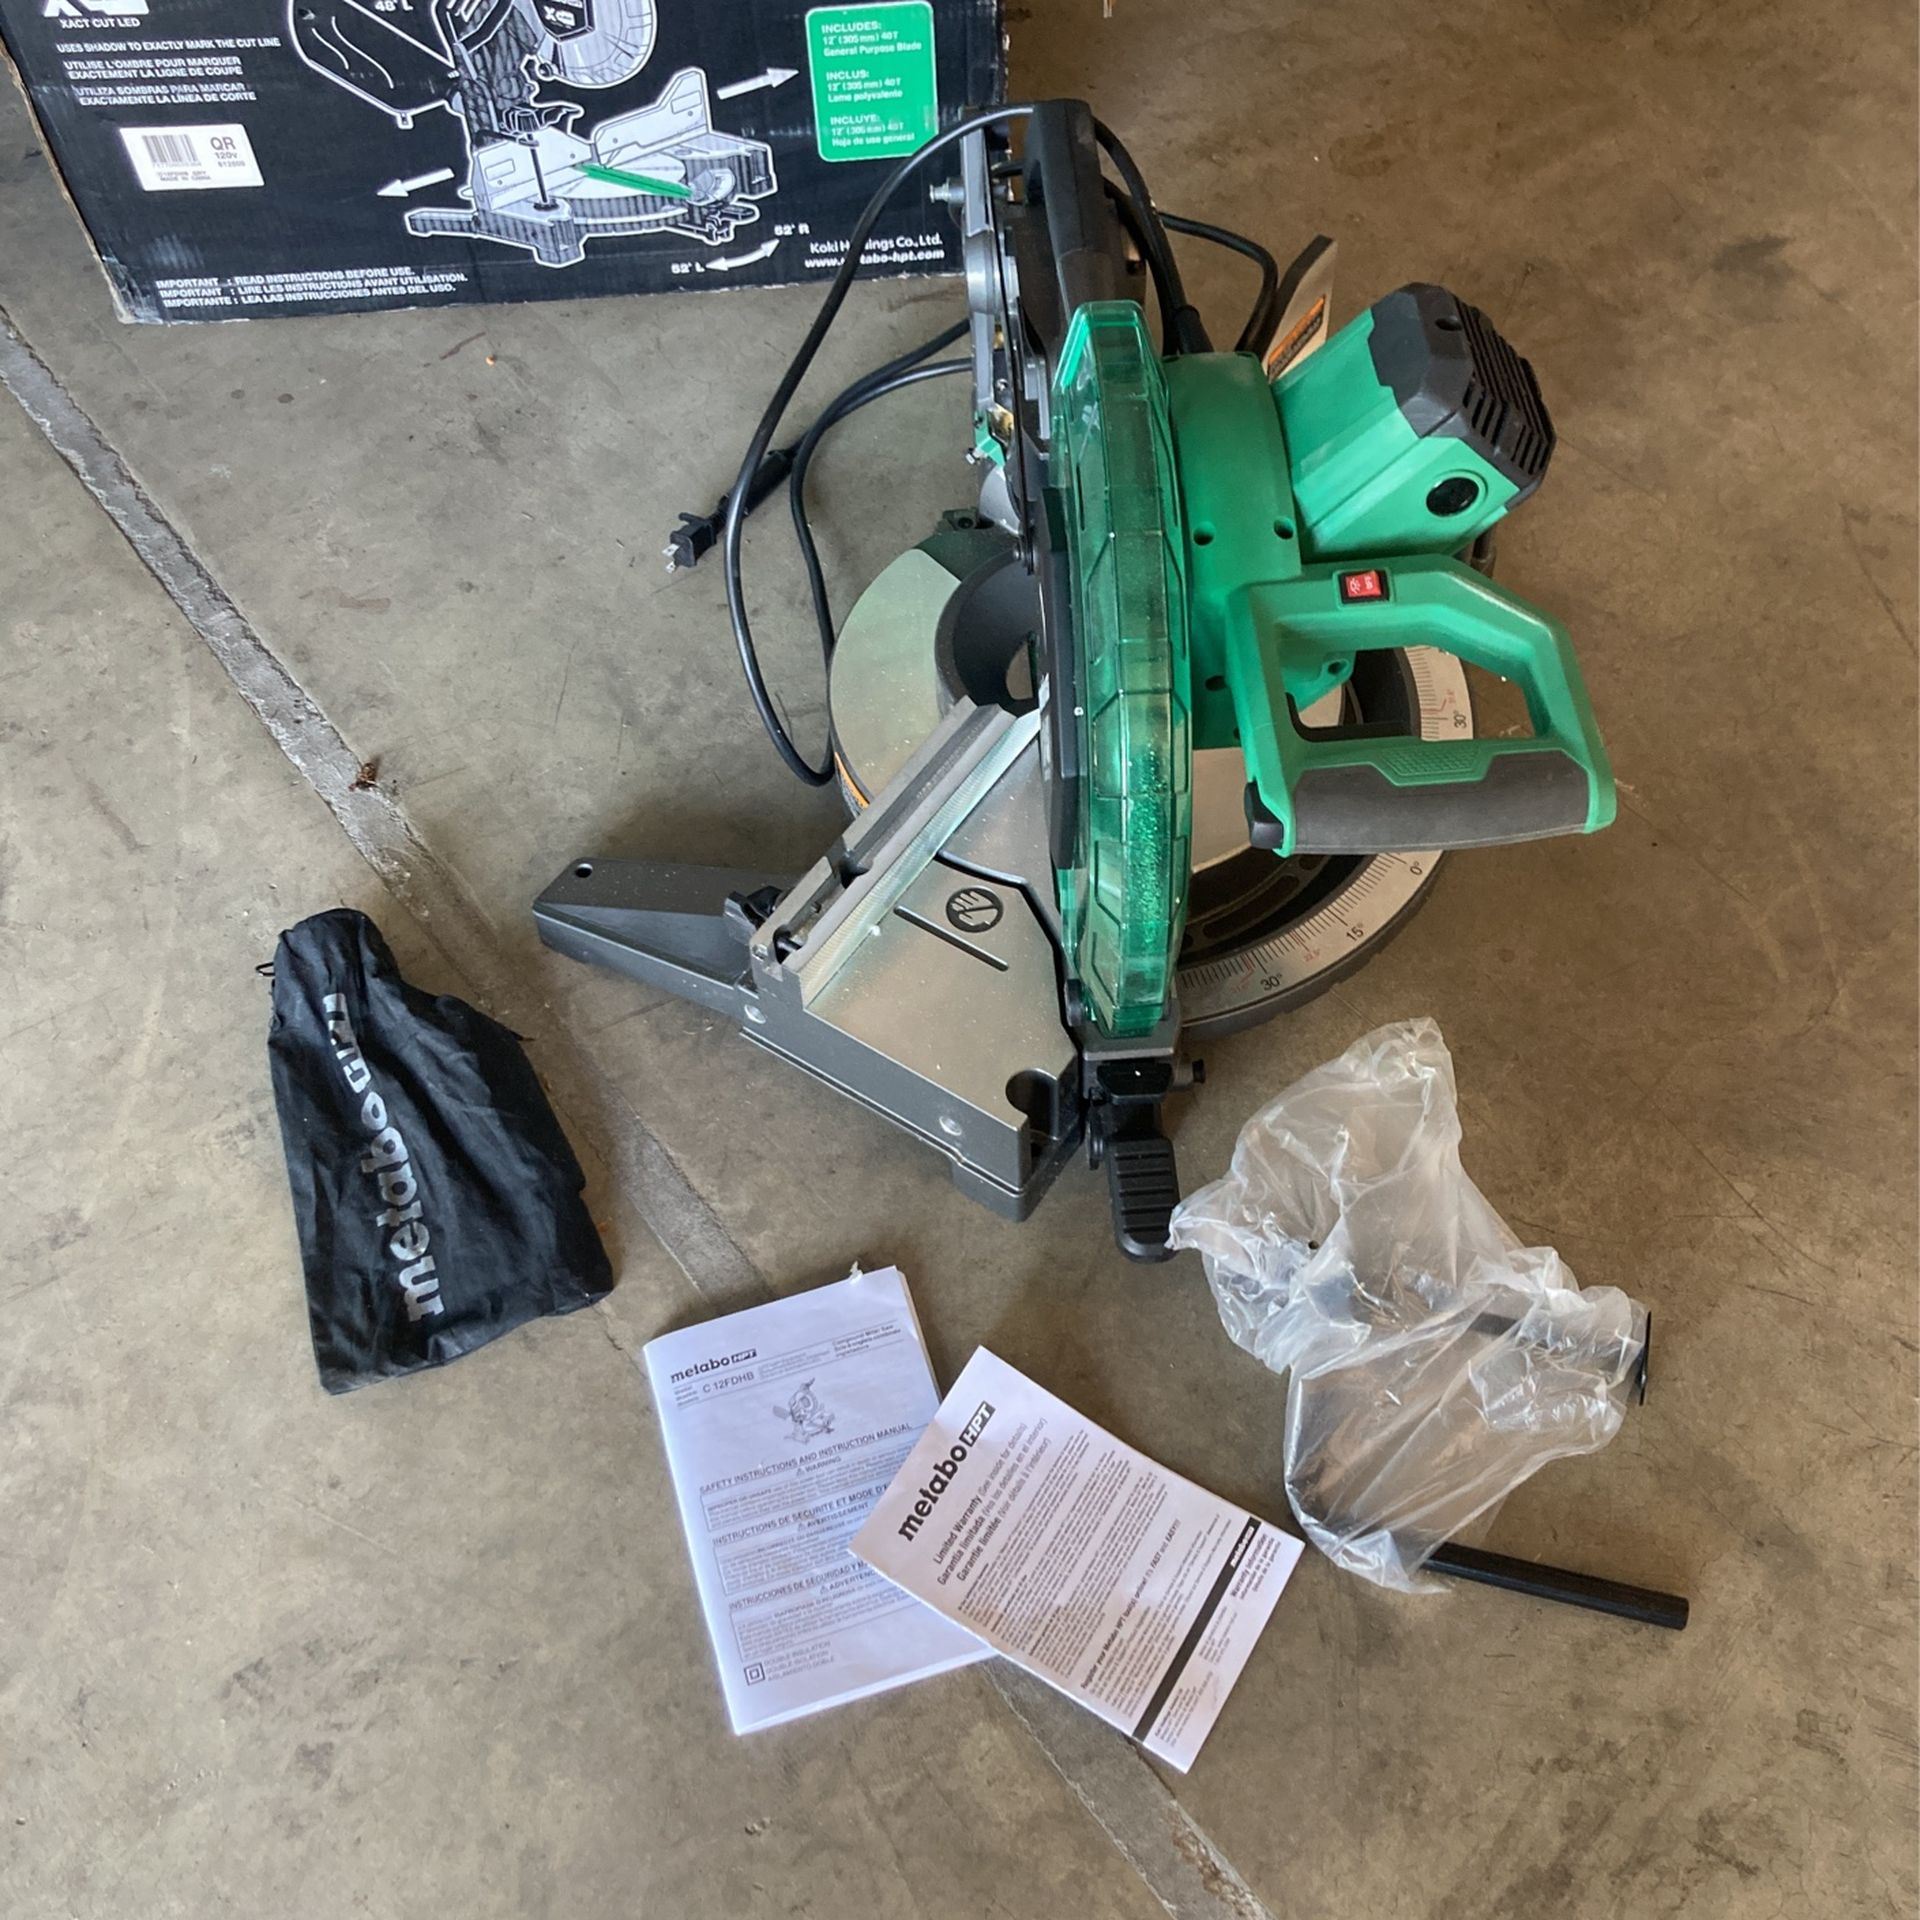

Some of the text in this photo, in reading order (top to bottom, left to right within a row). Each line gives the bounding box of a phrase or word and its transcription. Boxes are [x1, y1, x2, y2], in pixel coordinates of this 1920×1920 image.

[60, 17, 141, 29] XACT CUT LED
[821, 20, 881, 34] INCLUDES:
[56, 37, 281, 53] USES SHADOW TO EXACTLY MARK THE CUT LINE
[823, 46, 857, 57] General
[63, 56, 242, 70] UTILISE L'OMBRE POUR MARQUER
[68, 66, 243, 80] EXACTEMENT LA LIGNE DE COUPE
[826, 69, 869, 81] INCLUS:
[74, 82, 246, 96] UTILIZA SOMBRAS PARA MARCAR
[79, 95, 156, 106] EXACTAMENTE
[155, 94, 171, 103] LA
[203, 92, 219, 102] DE
[219, 91, 257, 101] CORTE
[210, 136, 236, 150] QR
[798, 223, 810, 234] R
[810, 240, 839, 254] Koki
[155, 266, 415, 289] IMPORTANT READ INSTRUCTIONS BEFORE USE.
[159, 273, 468, 299] IMPORTANT LIRE LES INSTRUCTIONS AVANT UTILISATION.
[162, 283, 456, 308] IMPORTANTE LEA LAS INSTRUCCIONES ANTES DEL USO.
[1346, 922, 1364, 942] 15°
[1260, 972, 1283, 991] 30°
[361, 1091, 444, 1322] metabo
[670, 1356, 730, 1382] metabo
[701, 1371, 754, 1394] C 12FDHB
[699, 1422, 912, 1494] SAFETY INSTRUCTIONS AND INSTRUCTION MANUAL
[804, 1456, 842, 1472] WARNING
[897, 1400, 995, 1542] metabo HPT
[805, 1501, 868, 1528] AVERTISSEMENT
[932, 1531, 958, 1565] Limited
[952, 1494, 982, 1532] Warranty
[988, 1458, 1005, 1480] inside
[999, 1447, 1010, 1460] for
[712, 1519, 777, 1546] INSTRUCTIONS
[777, 1514, 790, 1525] DE
[835, 1496, 846, 1507] ET
[848, 1487, 874, 1502] MODE
[958, 1515, 985, 1550] limitada
[955, 1544, 983, 1581] Garantie
[1149, 1551, 1161, 1568] FAST
[727, 1584, 792, 1610] INSTRUCCIONES
[792, 1580, 805, 1591] DE
[804, 1564, 850, 1587] SEGURIDAD
[1229, 1568, 1250, 1597] Warranty
